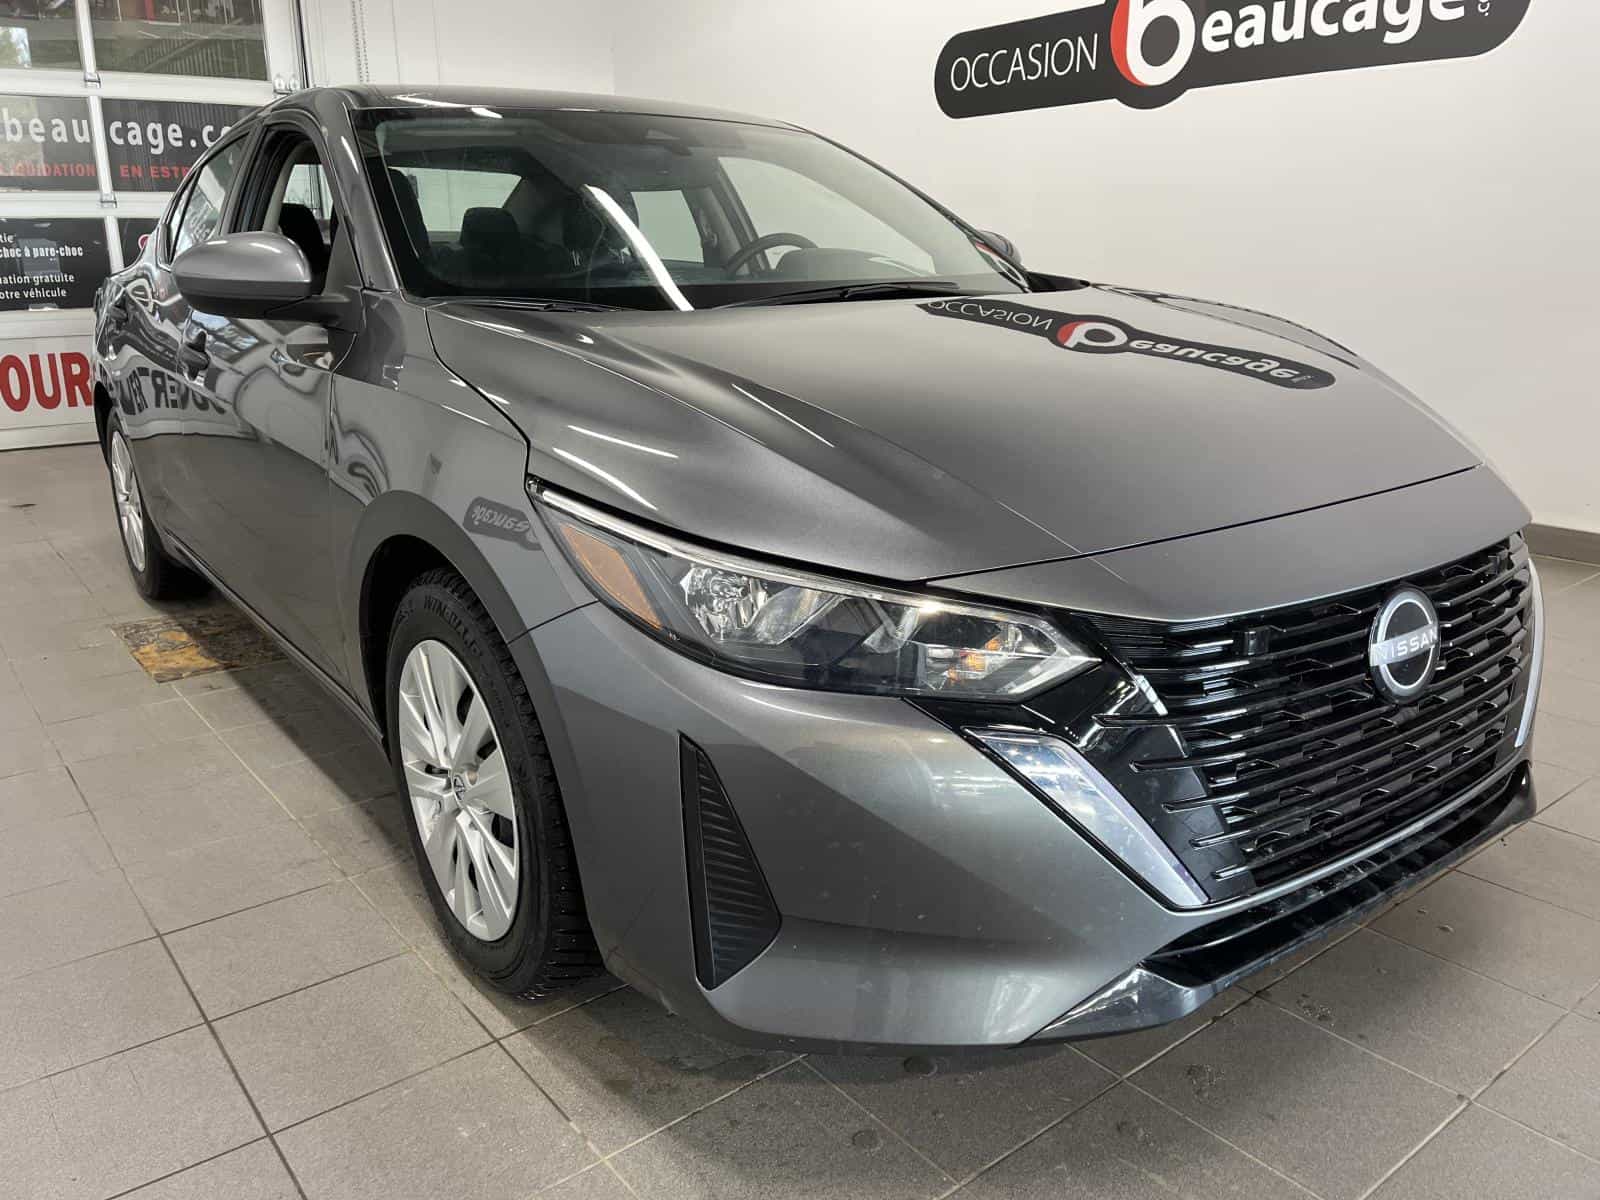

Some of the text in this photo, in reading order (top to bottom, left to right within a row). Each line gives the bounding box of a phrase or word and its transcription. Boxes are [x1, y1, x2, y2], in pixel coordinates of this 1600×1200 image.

[950, 32, 1099, 92] OCCASION
[120, 165, 143, 177] EN
[0, 271, 75, 286] ation gratuite
[23, 287, 67, 299] véhicule
[0, 352, 93, 413] OUR
[1374, 628, 1438, 662] NISSAN
